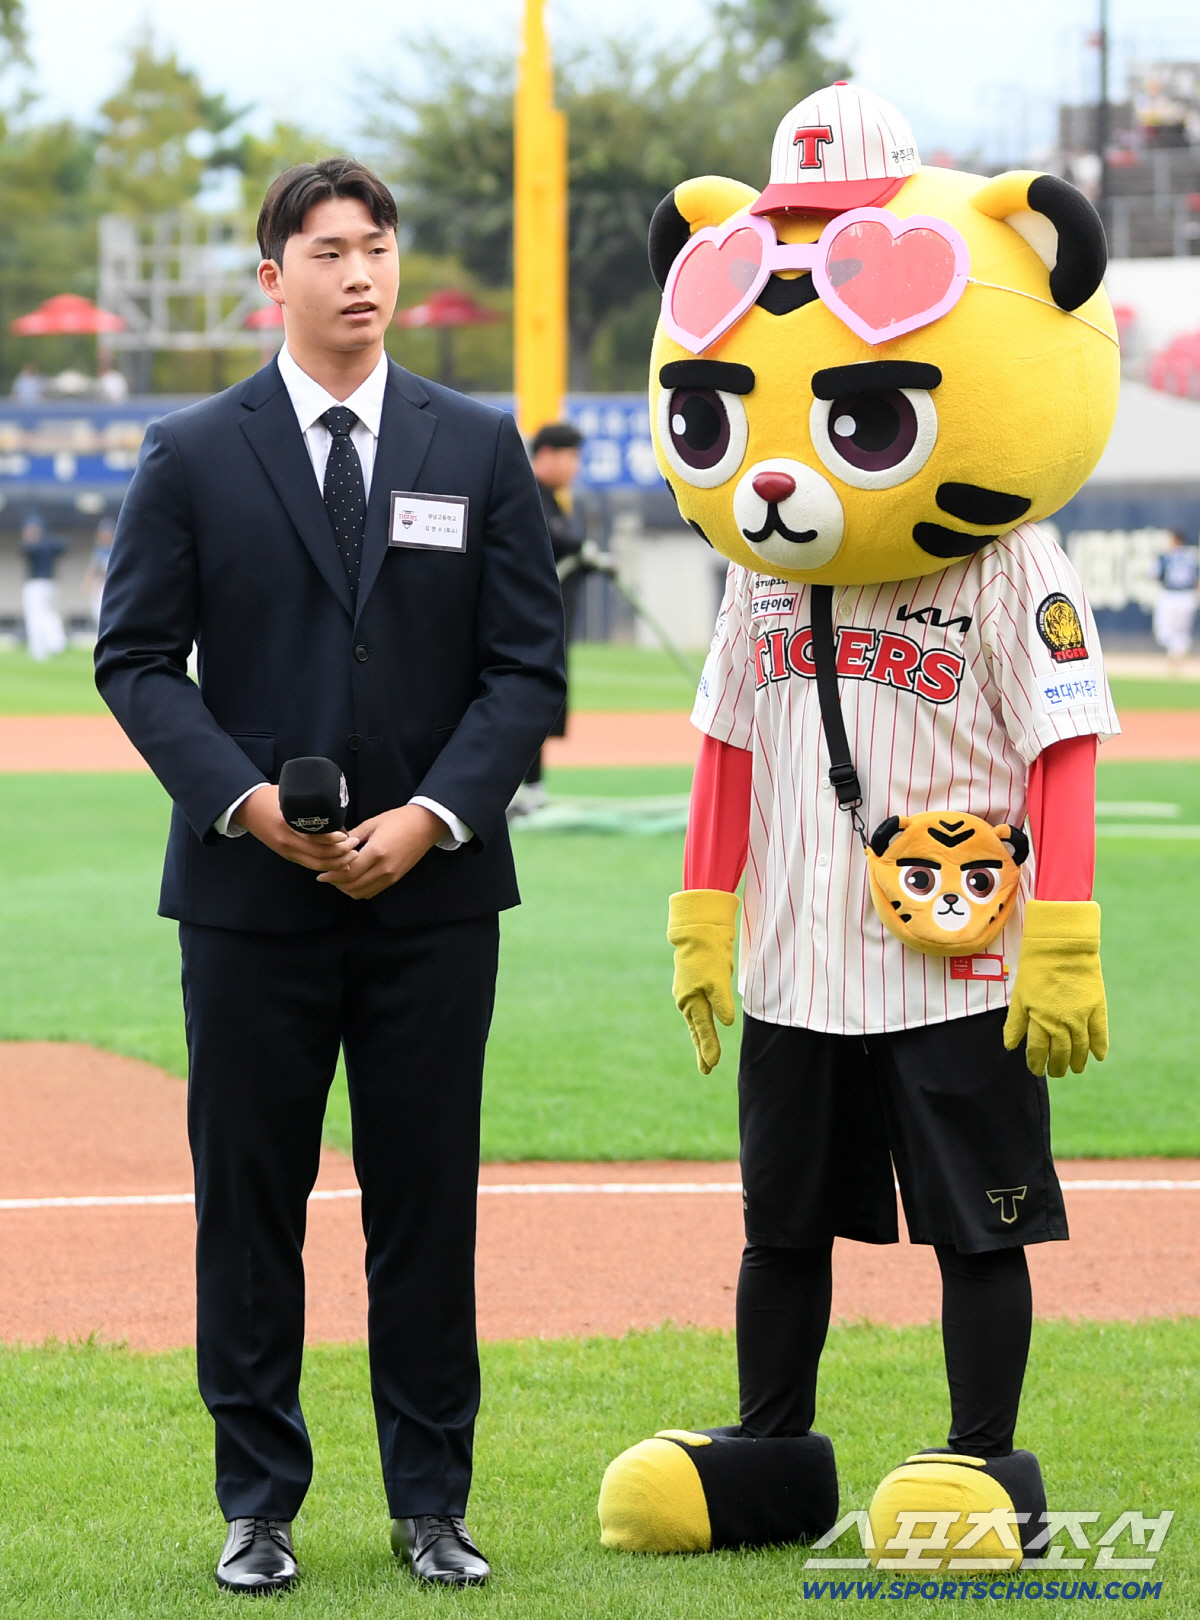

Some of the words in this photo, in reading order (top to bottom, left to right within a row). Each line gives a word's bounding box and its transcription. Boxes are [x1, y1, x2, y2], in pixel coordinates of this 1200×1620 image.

[793, 125, 834, 169] T
[752, 597, 795, 615] 호타이어
[896, 604, 973, 633] KIA
[755, 625, 967, 705] TIGERS
[986, 1185, 1028, 1224] T
